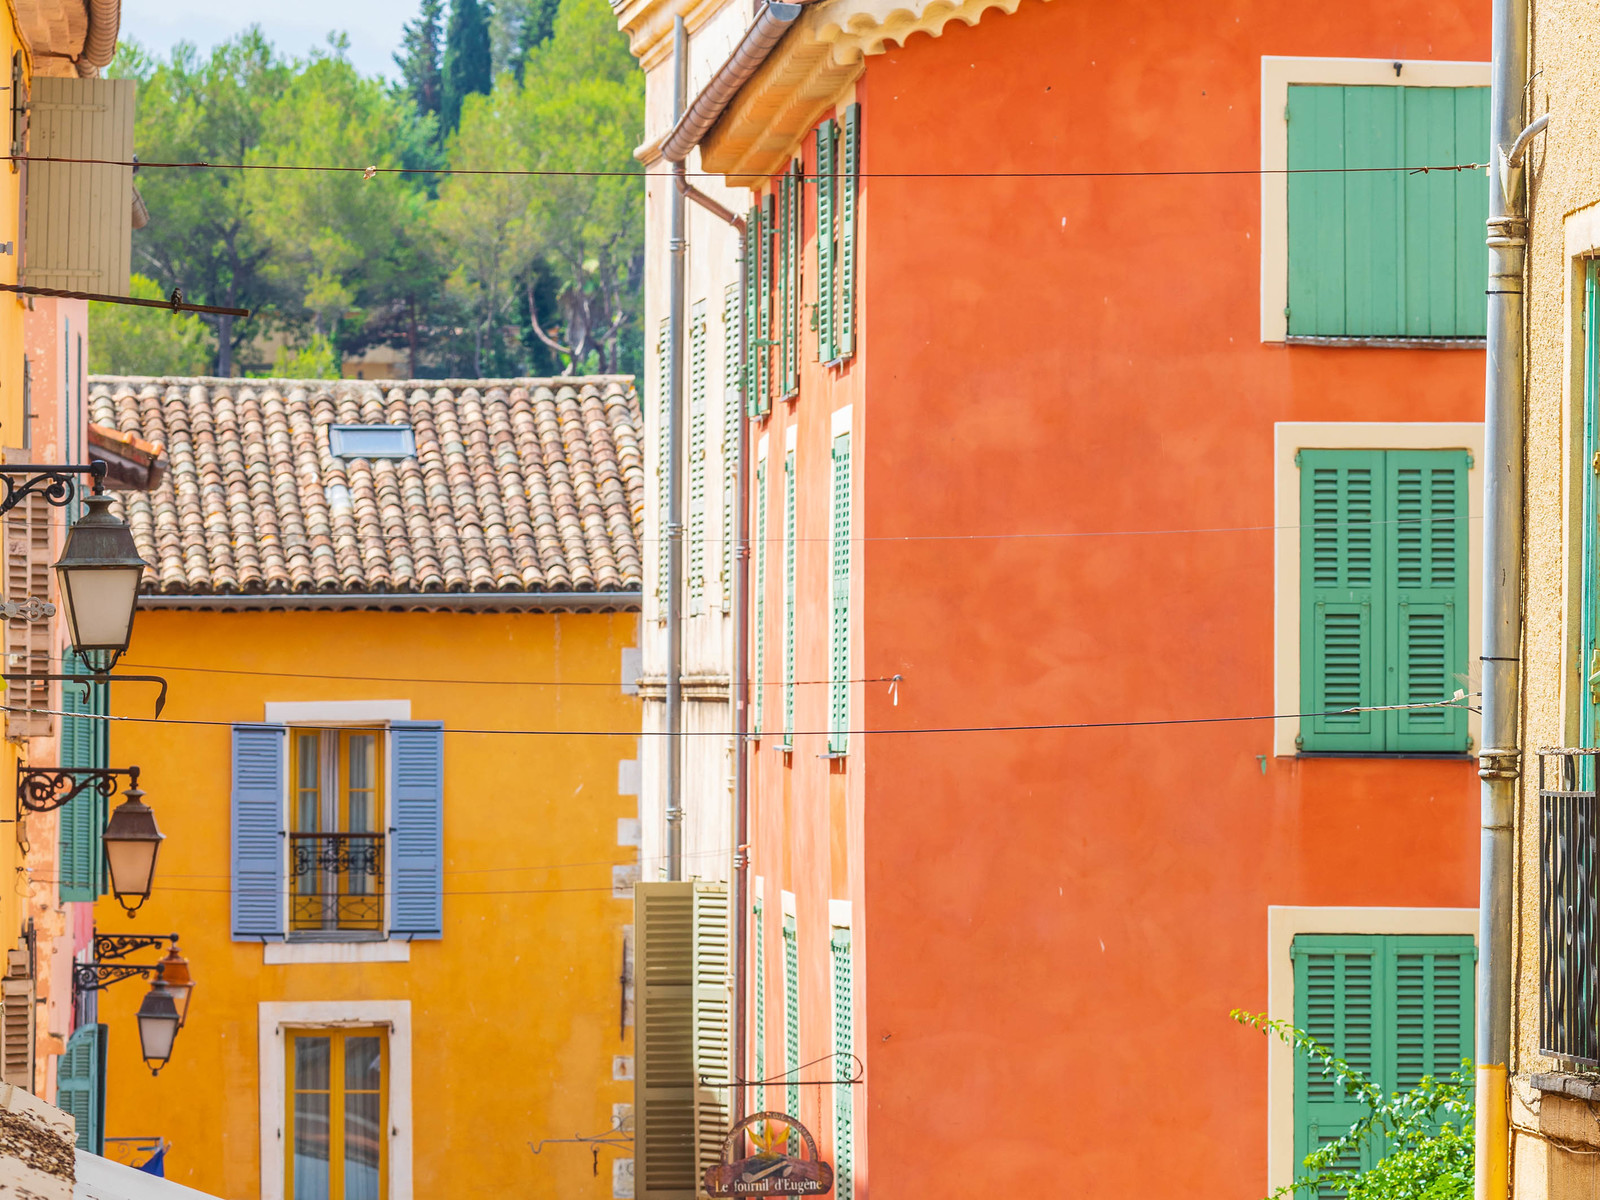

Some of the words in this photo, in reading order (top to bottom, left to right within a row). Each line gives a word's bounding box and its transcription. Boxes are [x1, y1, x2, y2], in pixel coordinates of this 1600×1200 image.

[715, 1181, 728, 1192] Le
[734, 1179, 769, 1192] fournil
[775, 1178, 823, 1193] d'Eugène
